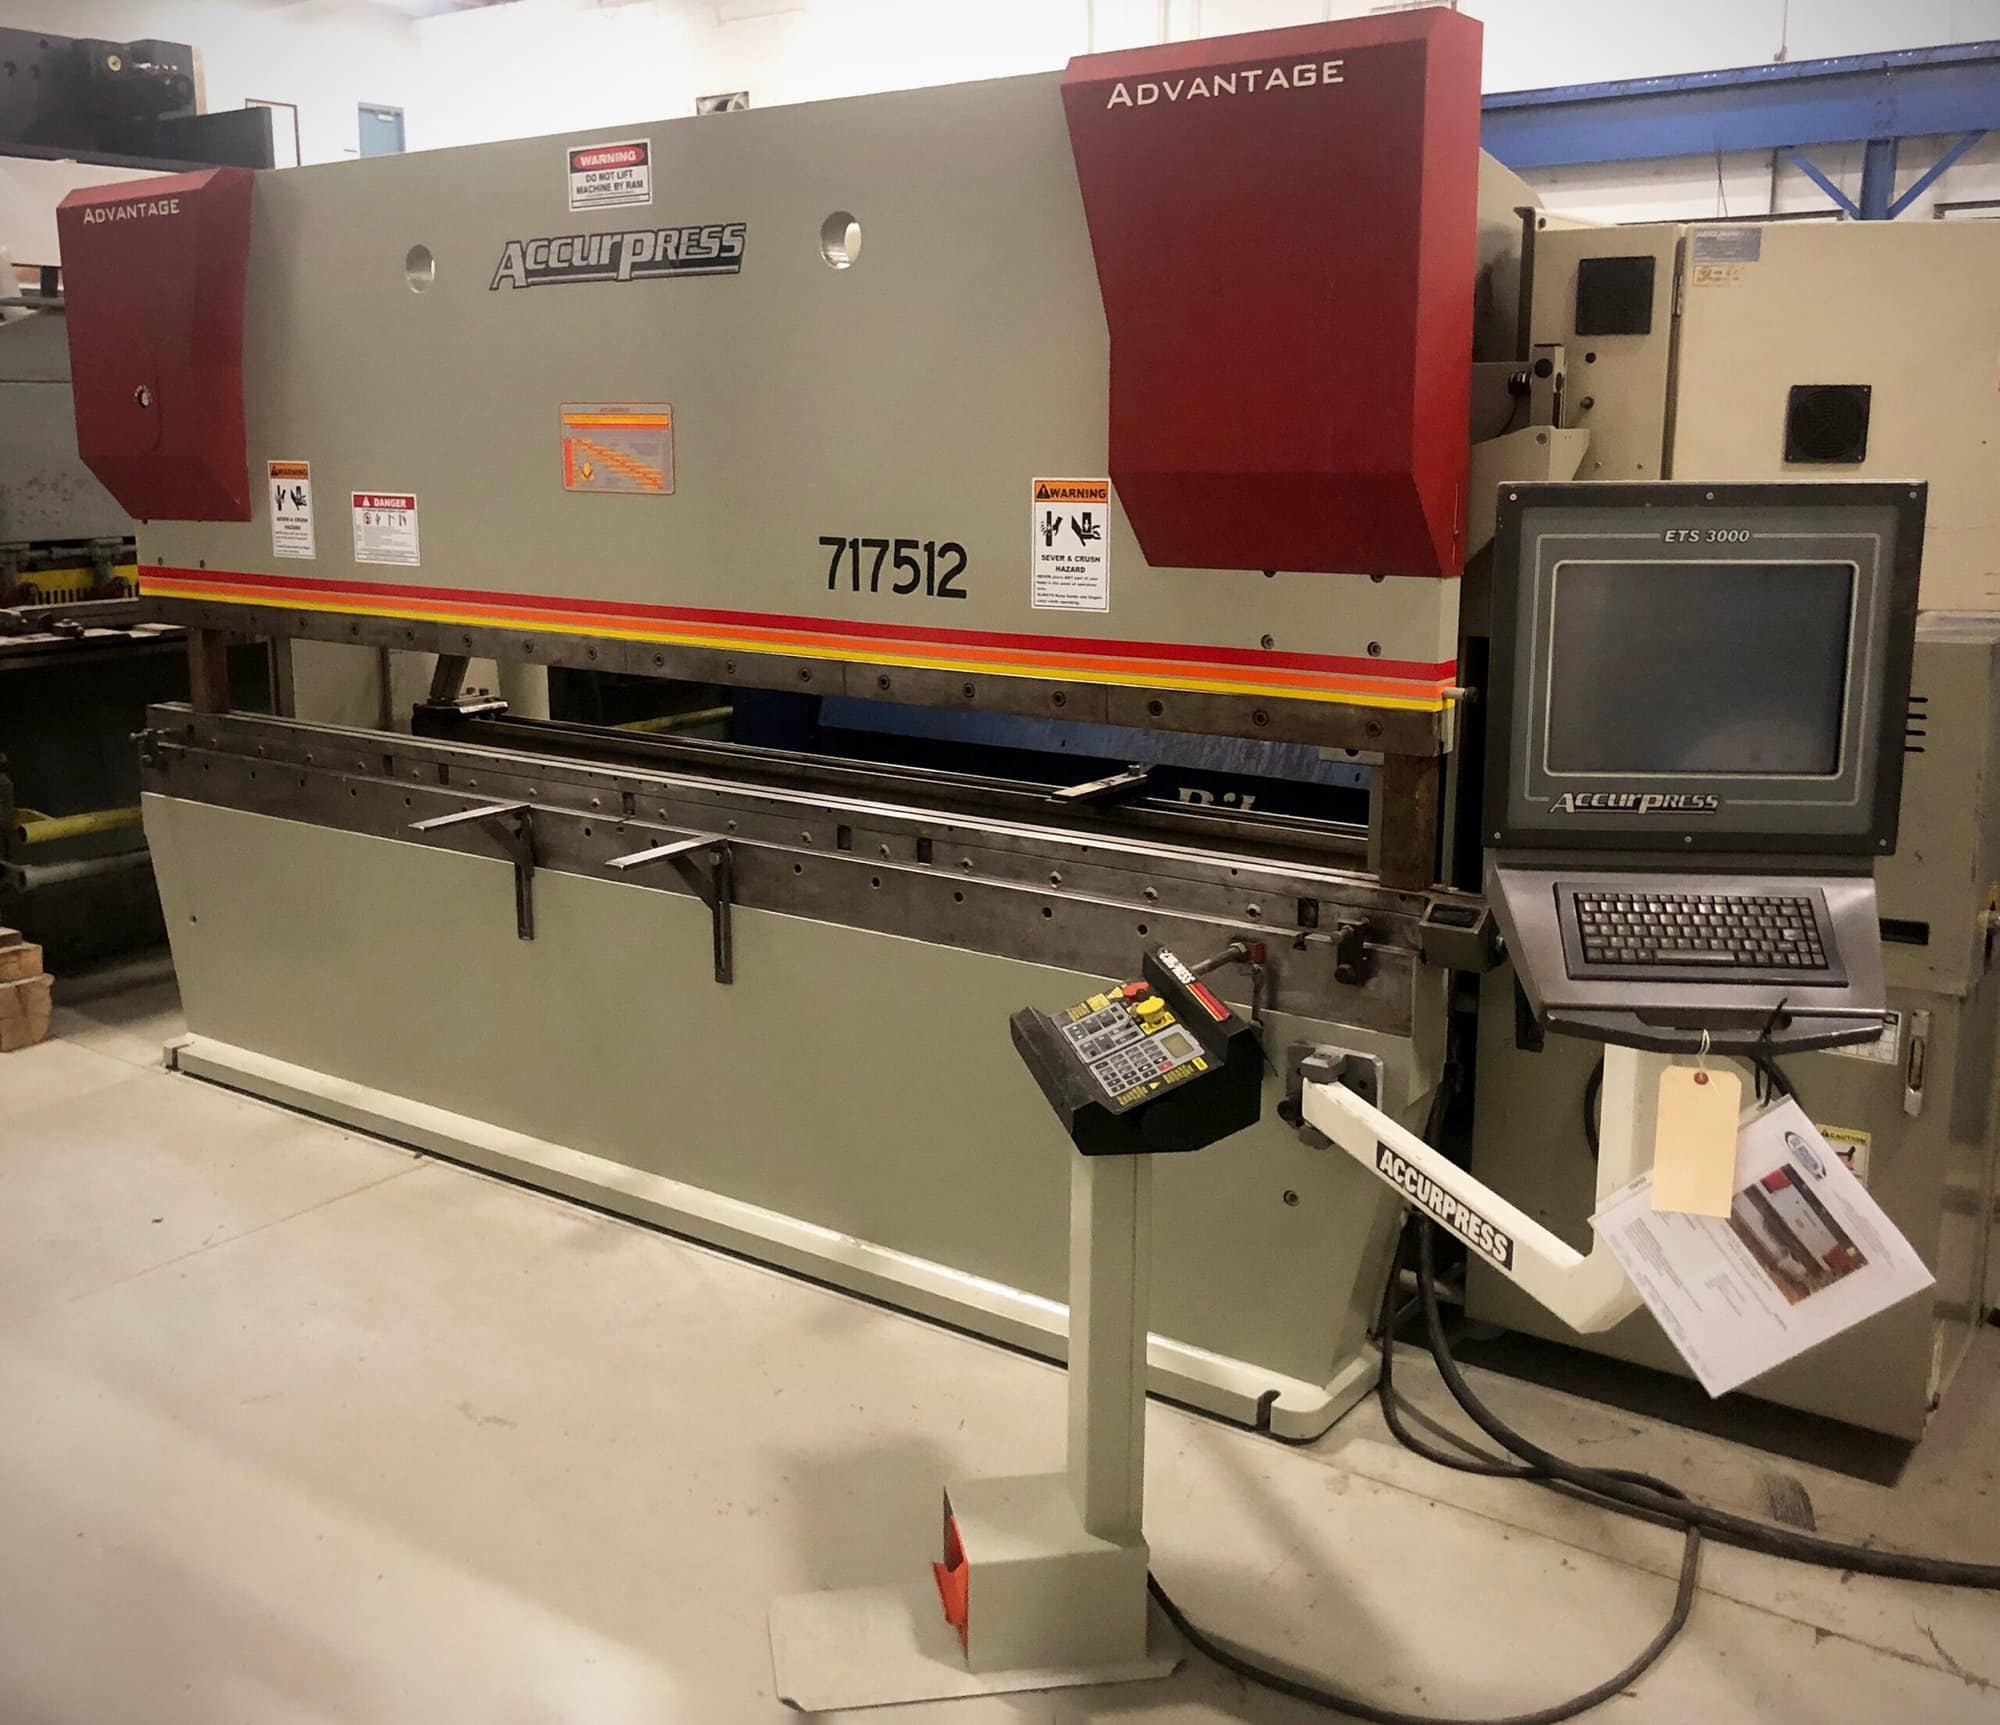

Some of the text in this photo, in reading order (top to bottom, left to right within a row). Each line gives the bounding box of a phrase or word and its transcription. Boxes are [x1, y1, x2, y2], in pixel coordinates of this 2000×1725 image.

[1106, 60, 1344, 109] ADVANTAGE
[580, 150, 637, 167] WARNING
[585, 170, 633, 183] DO NOT LIFT
[576, 183, 612, 194] MACHINE
[613, 182, 625, 191] BY
[625, 180, 643, 189] RAM
[83, 199, 180, 225] ADVANTAGE
[1050, 488, 1106, 499] WARNING
[374, 498, 407, 508] DANGER
[1664, 529, 1750, 542] ETS 3000
[1041, 554, 1065, 562] SEVER
[1075, 555, 1101, 563] CRUSH
[819, 536, 967, 599] 717512
[1056, 565, 1086, 574] HAZARD
[1378, 1149, 1509, 1262] ACCURPRESS
